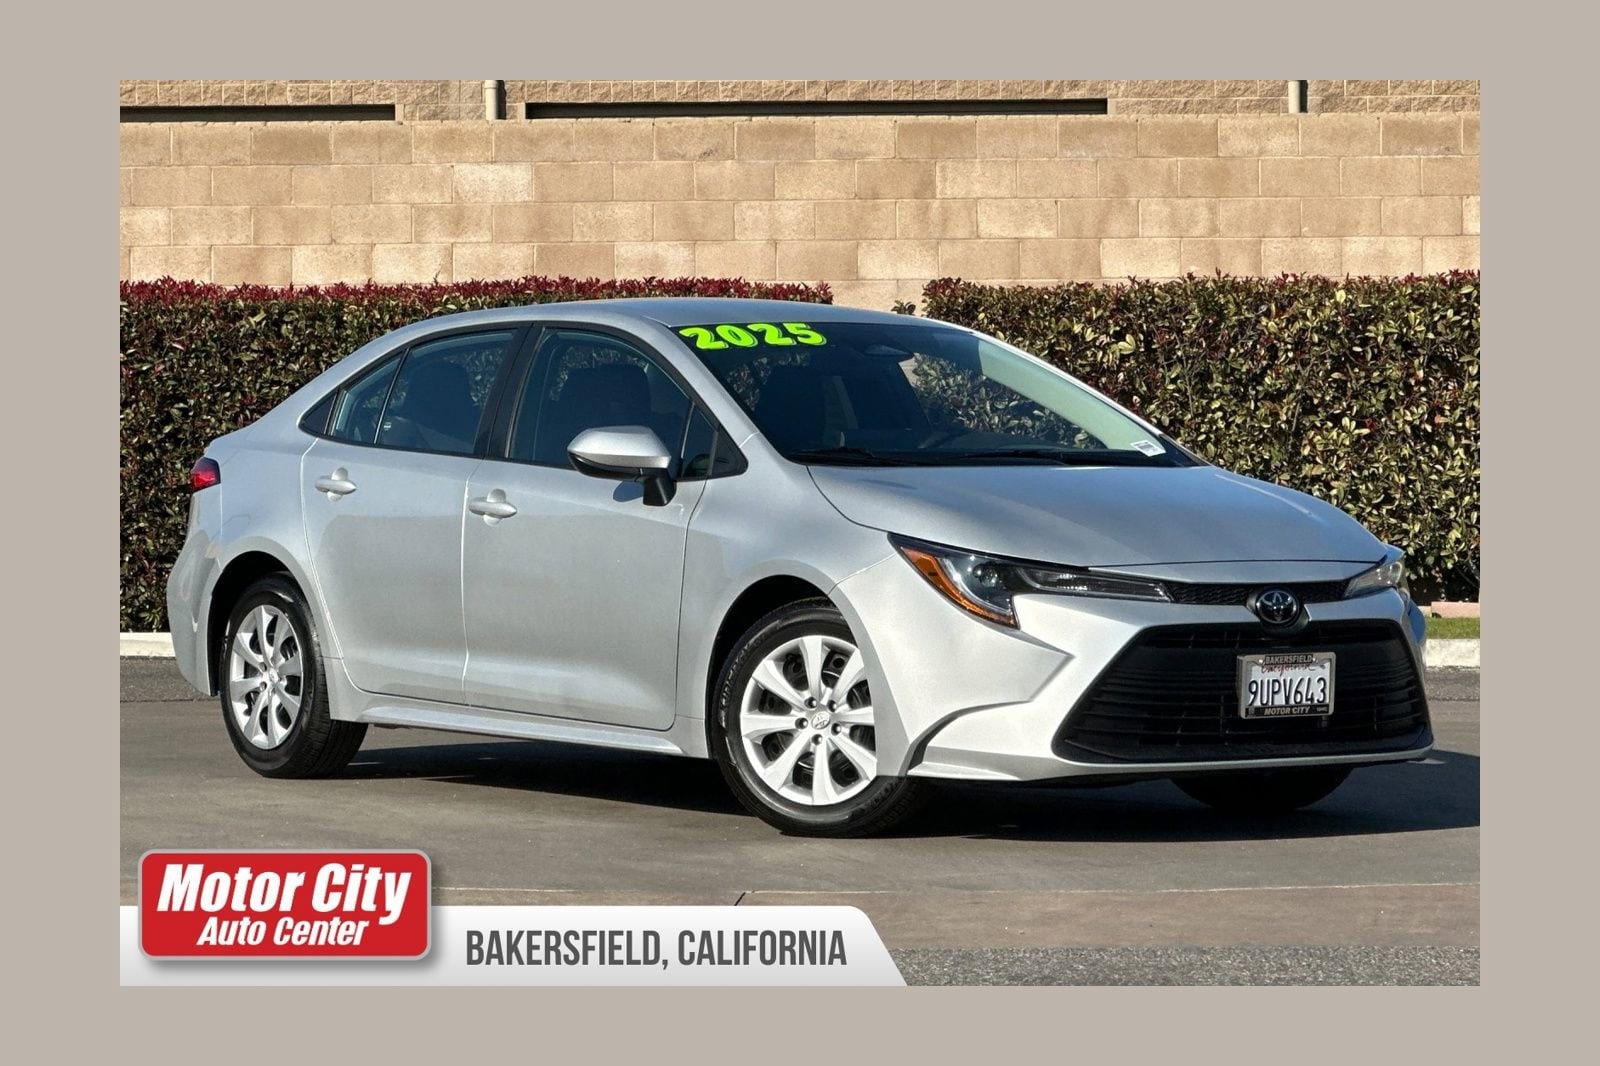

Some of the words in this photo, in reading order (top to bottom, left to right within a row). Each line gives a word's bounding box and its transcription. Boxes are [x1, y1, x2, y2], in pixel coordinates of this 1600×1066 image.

[678, 322, 828, 350] 2025
[1265, 655, 1313, 665] BAKERSFIELD
[1248, 676, 1327, 706] 9UPV643
[1263, 706, 1291, 716] MOTOR
[1292, 706, 1311, 714] CITY
